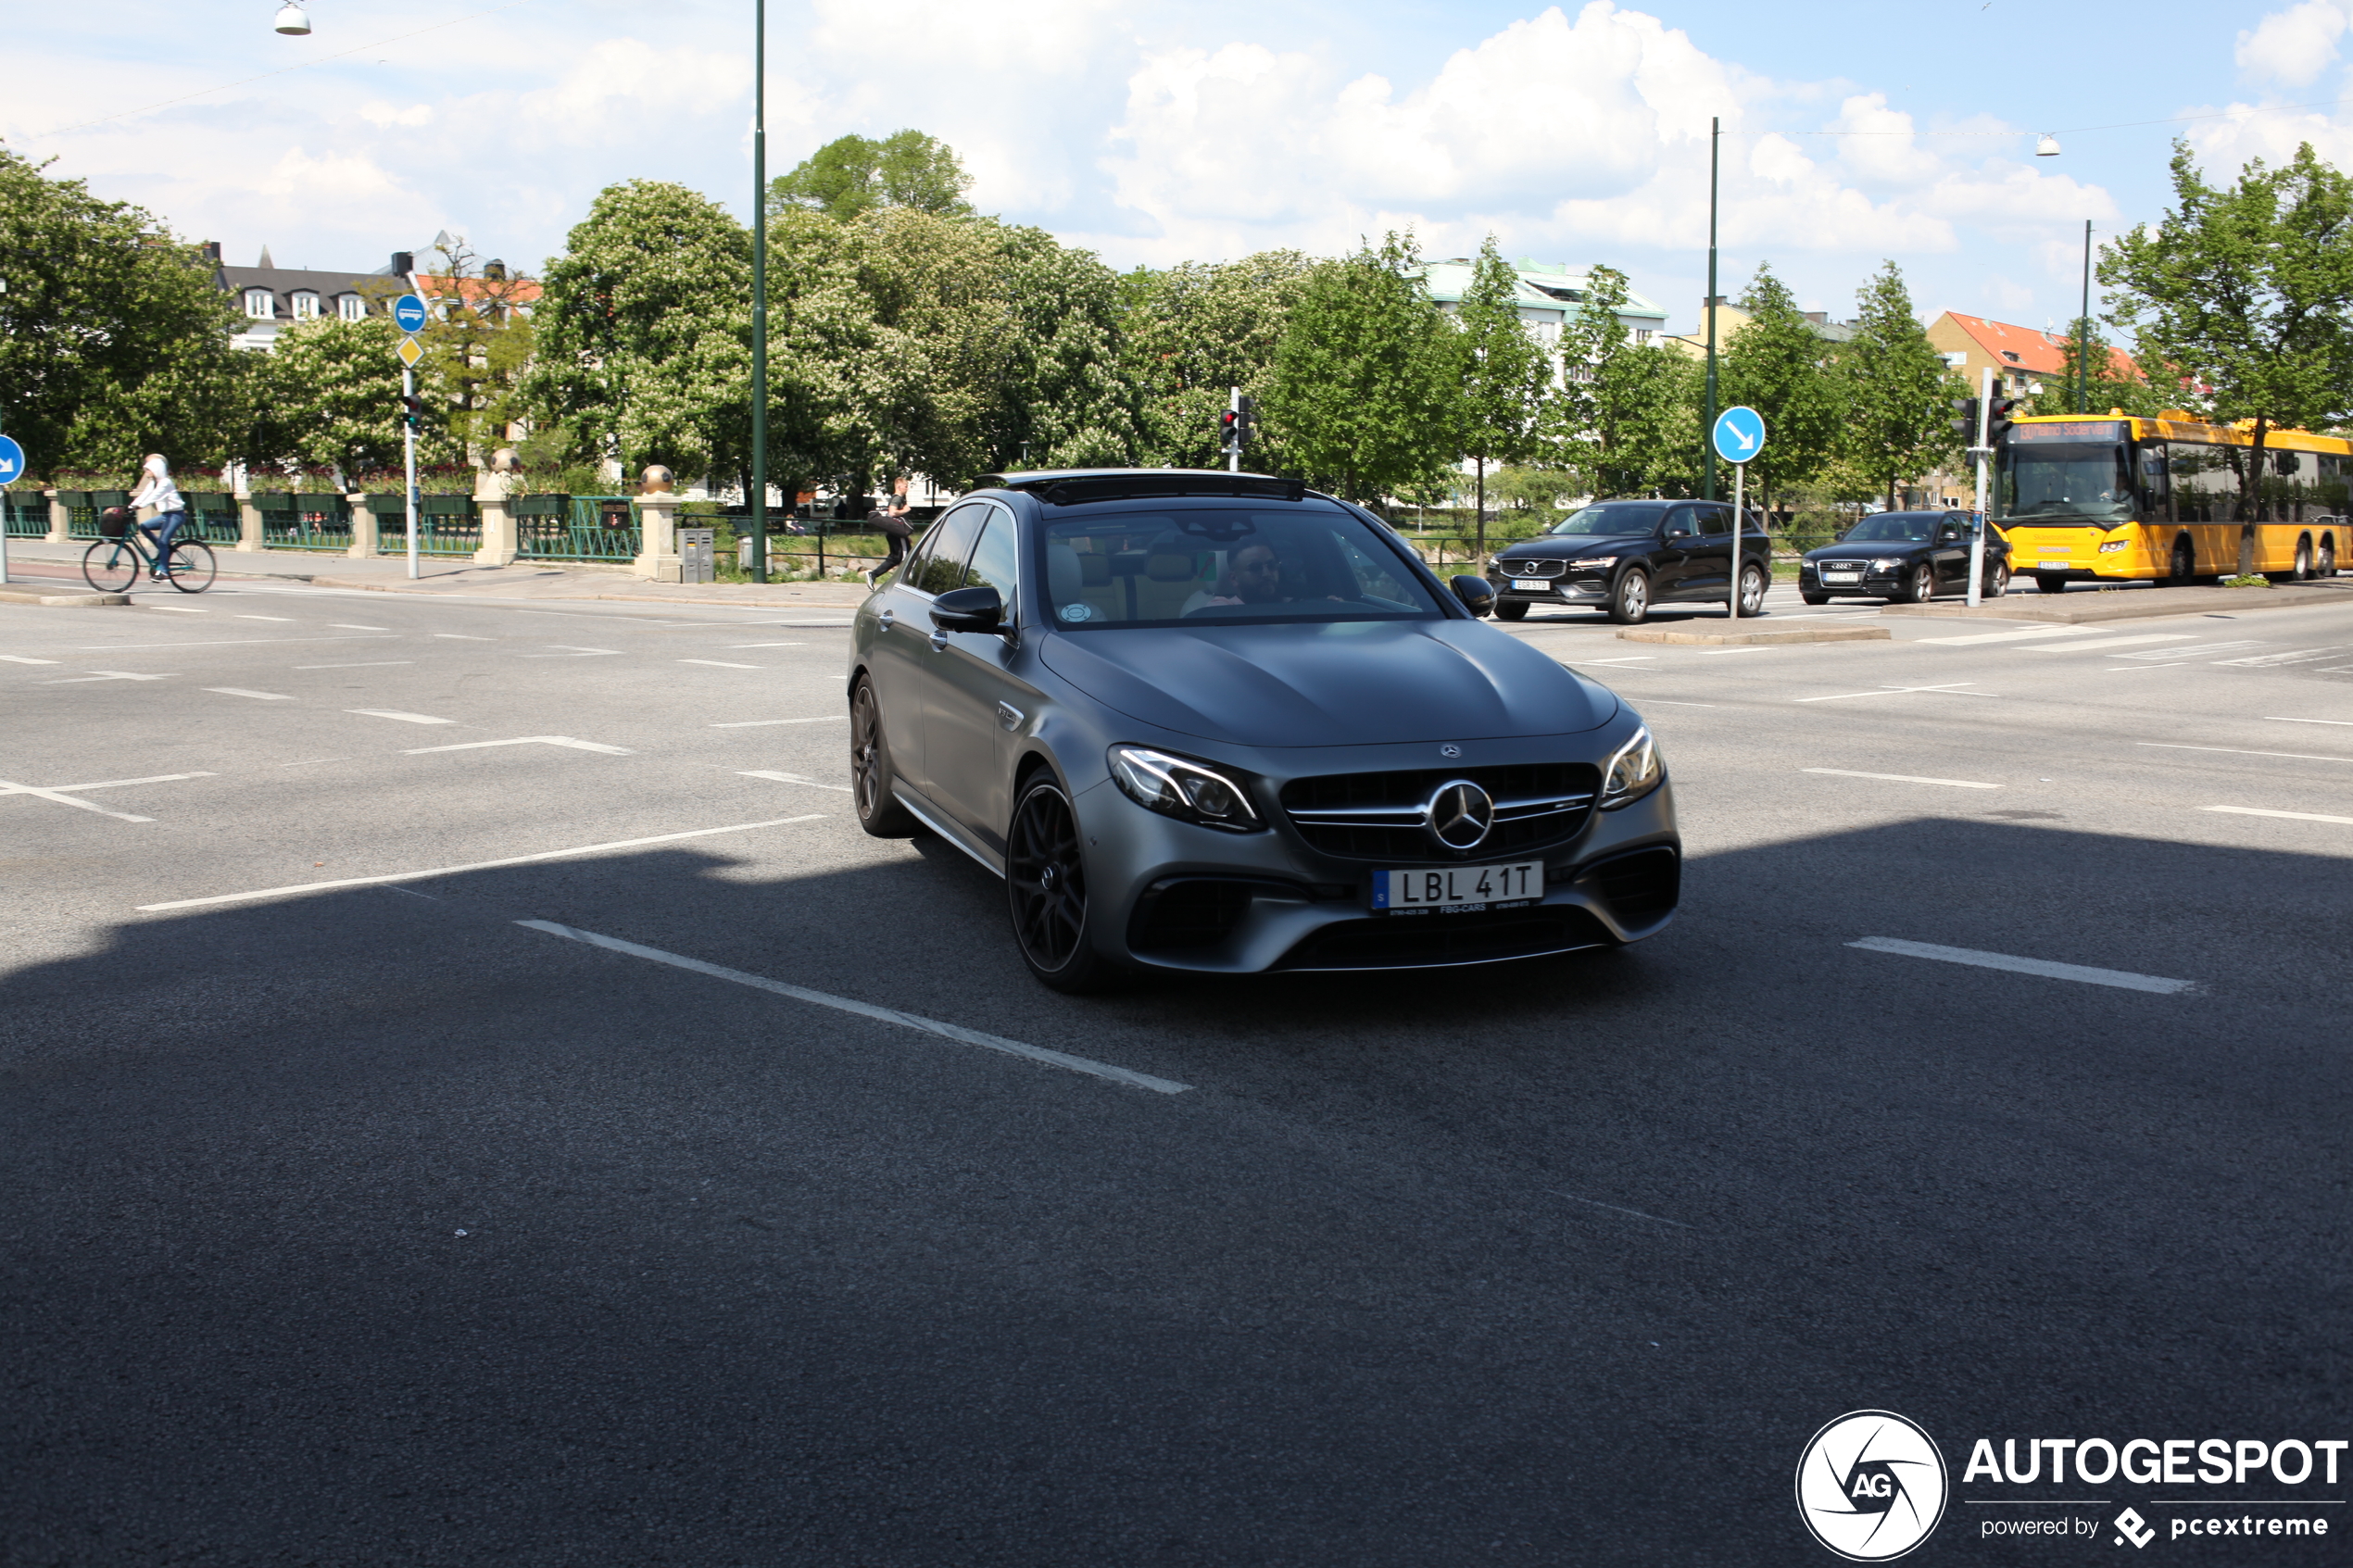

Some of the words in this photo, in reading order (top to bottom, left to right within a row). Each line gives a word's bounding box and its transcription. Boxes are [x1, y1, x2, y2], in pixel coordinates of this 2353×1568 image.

[2019, 424, 2032, 440] 130
[2033, 423, 2061, 436] Malmö
[2063, 421, 2114, 436] Södervärn
[1517, 581, 1531, 589] EGR
[1403, 872, 1463, 903] LBL
[1476, 865, 1531, 897] 41T
[1377, 894, 1385, 902] S
[1440, 903, 1487, 914] FBG-CARS
